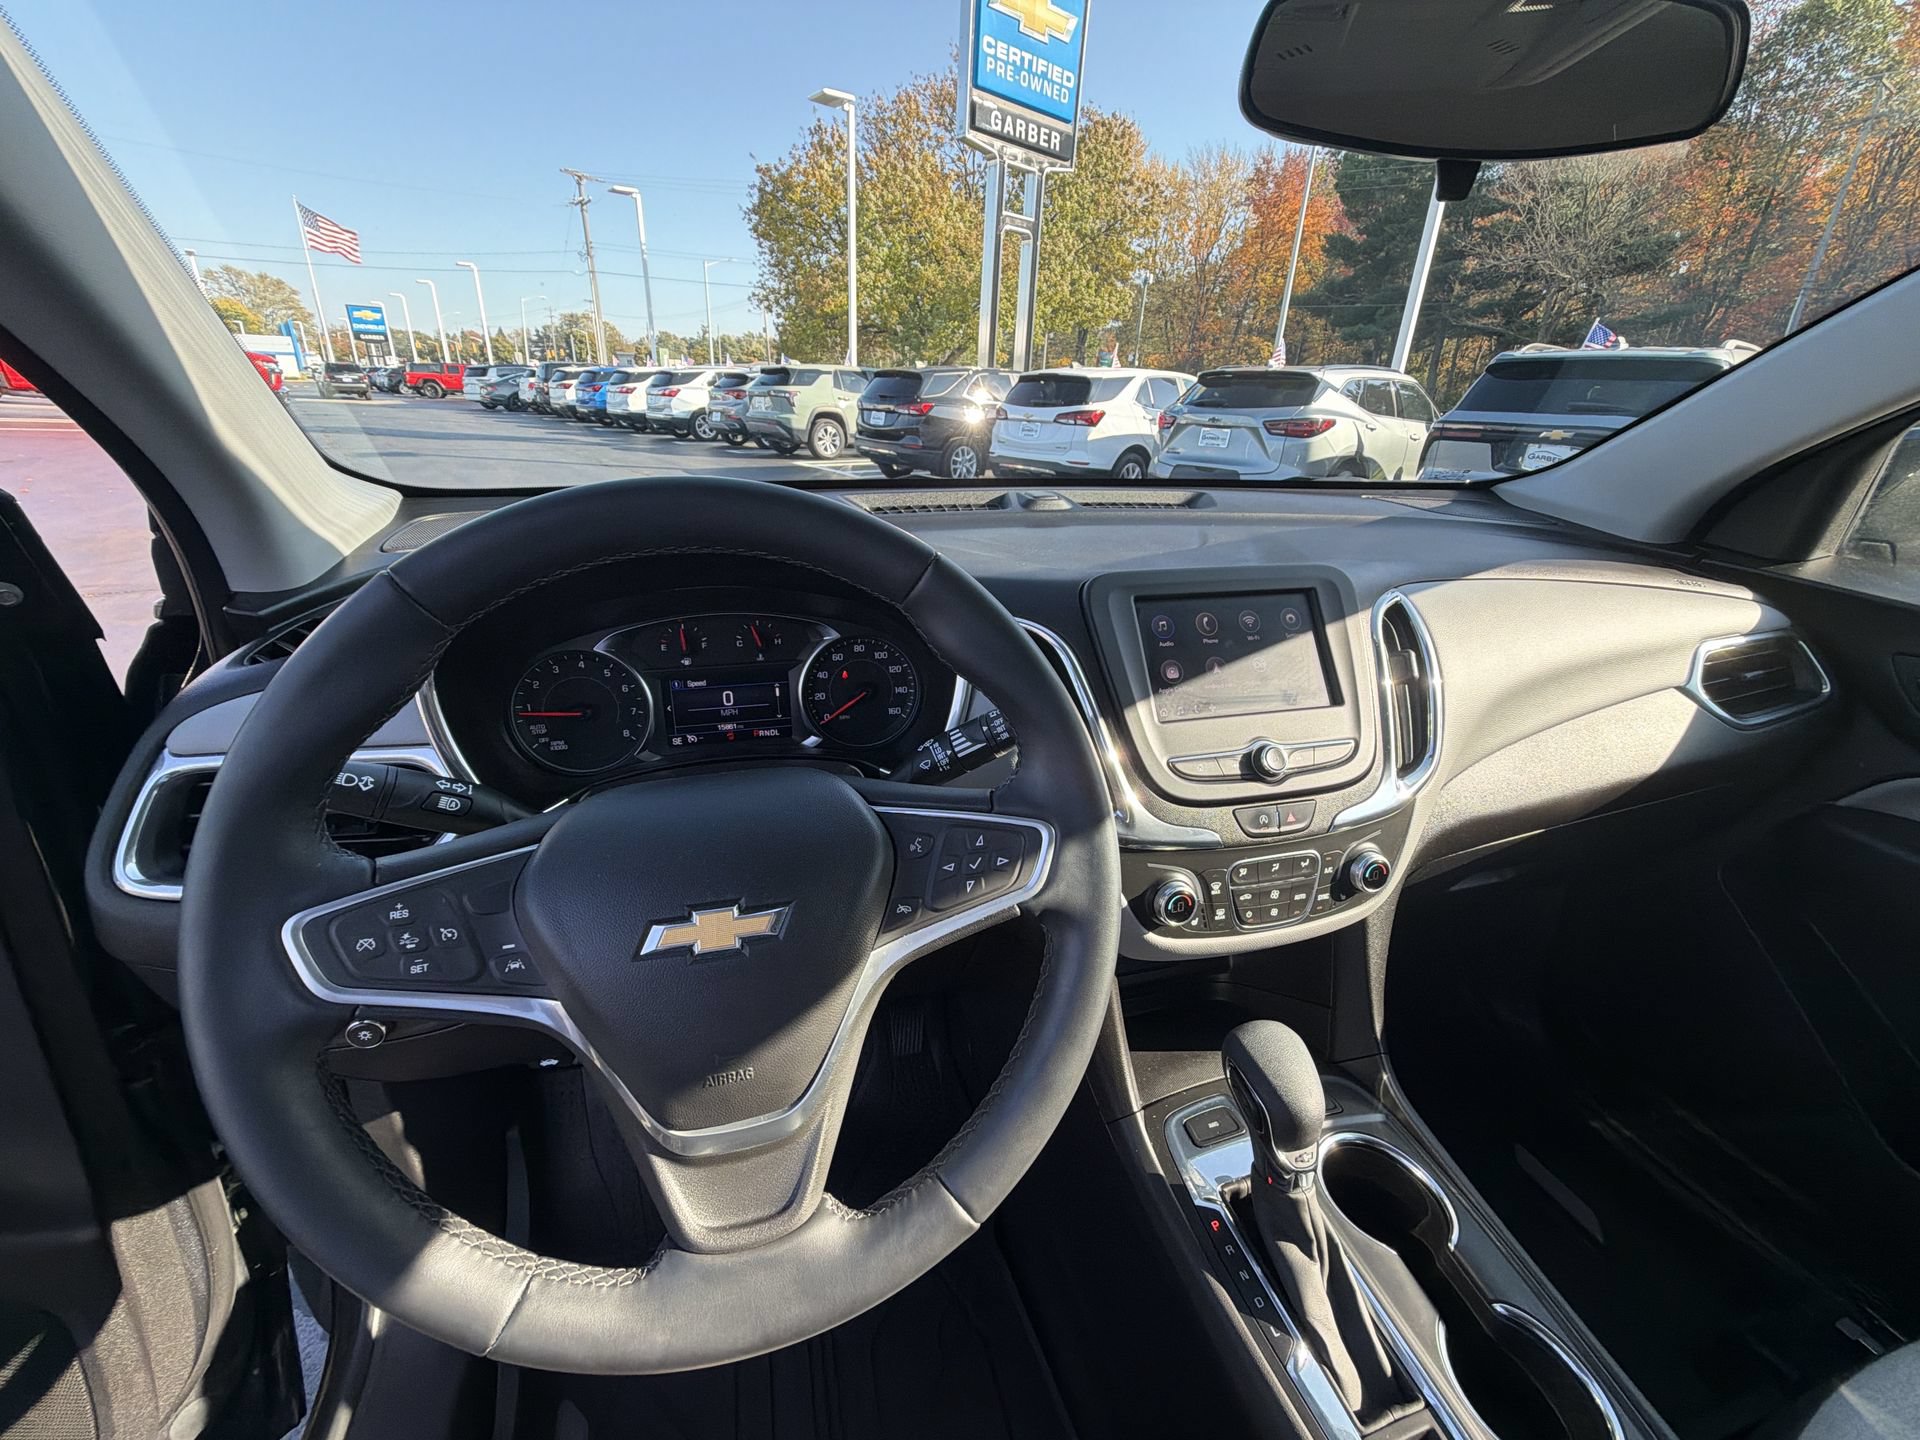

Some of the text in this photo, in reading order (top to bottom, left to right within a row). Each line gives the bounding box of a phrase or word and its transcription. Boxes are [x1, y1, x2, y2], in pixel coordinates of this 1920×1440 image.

[982, 34, 1075, 89] CERTIFIED
[986, 57, 1070, 104] PRE-OWNED
[990, 110, 1061, 152] GARBER
[853, 644, 865, 653] 80
[1158, 640, 1175, 648] Audio
[832, 653, 844, 661] 60
[874, 651, 888, 660] 100
[552, 665, 560, 674] 3
[577, 661, 585, 669] 4
[888, 665, 902, 673] 120
[603, 668, 611, 678] 5
[532, 680, 540, 689] 2
[621, 684, 629, 693] 6
[686, 680, 707, 689] Speed
[894, 686, 908, 694] 140
[722, 690, 734, 706] 0
[814, 692, 826, 701] 20
[629, 707, 637, 715] 7
[720, 708, 739, 717] MPH
[887, 706, 902, 715] 160
[993, 717, 1004, 726] OFF
[622, 729, 630, 737] 8
[672, 737, 683, 746] SE
[389, 909, 409, 920] RES
[410, 963, 430, 974] SET
[703, 1067, 754, 1088] AIRBAG
[1210, 1219, 1220, 1232] P
[1224, 1244, 1235, 1256] R
[1238, 1269, 1250, 1281] N
[1254, 1296, 1265, 1309] D
[1269, 1326, 1281, 1338] L
